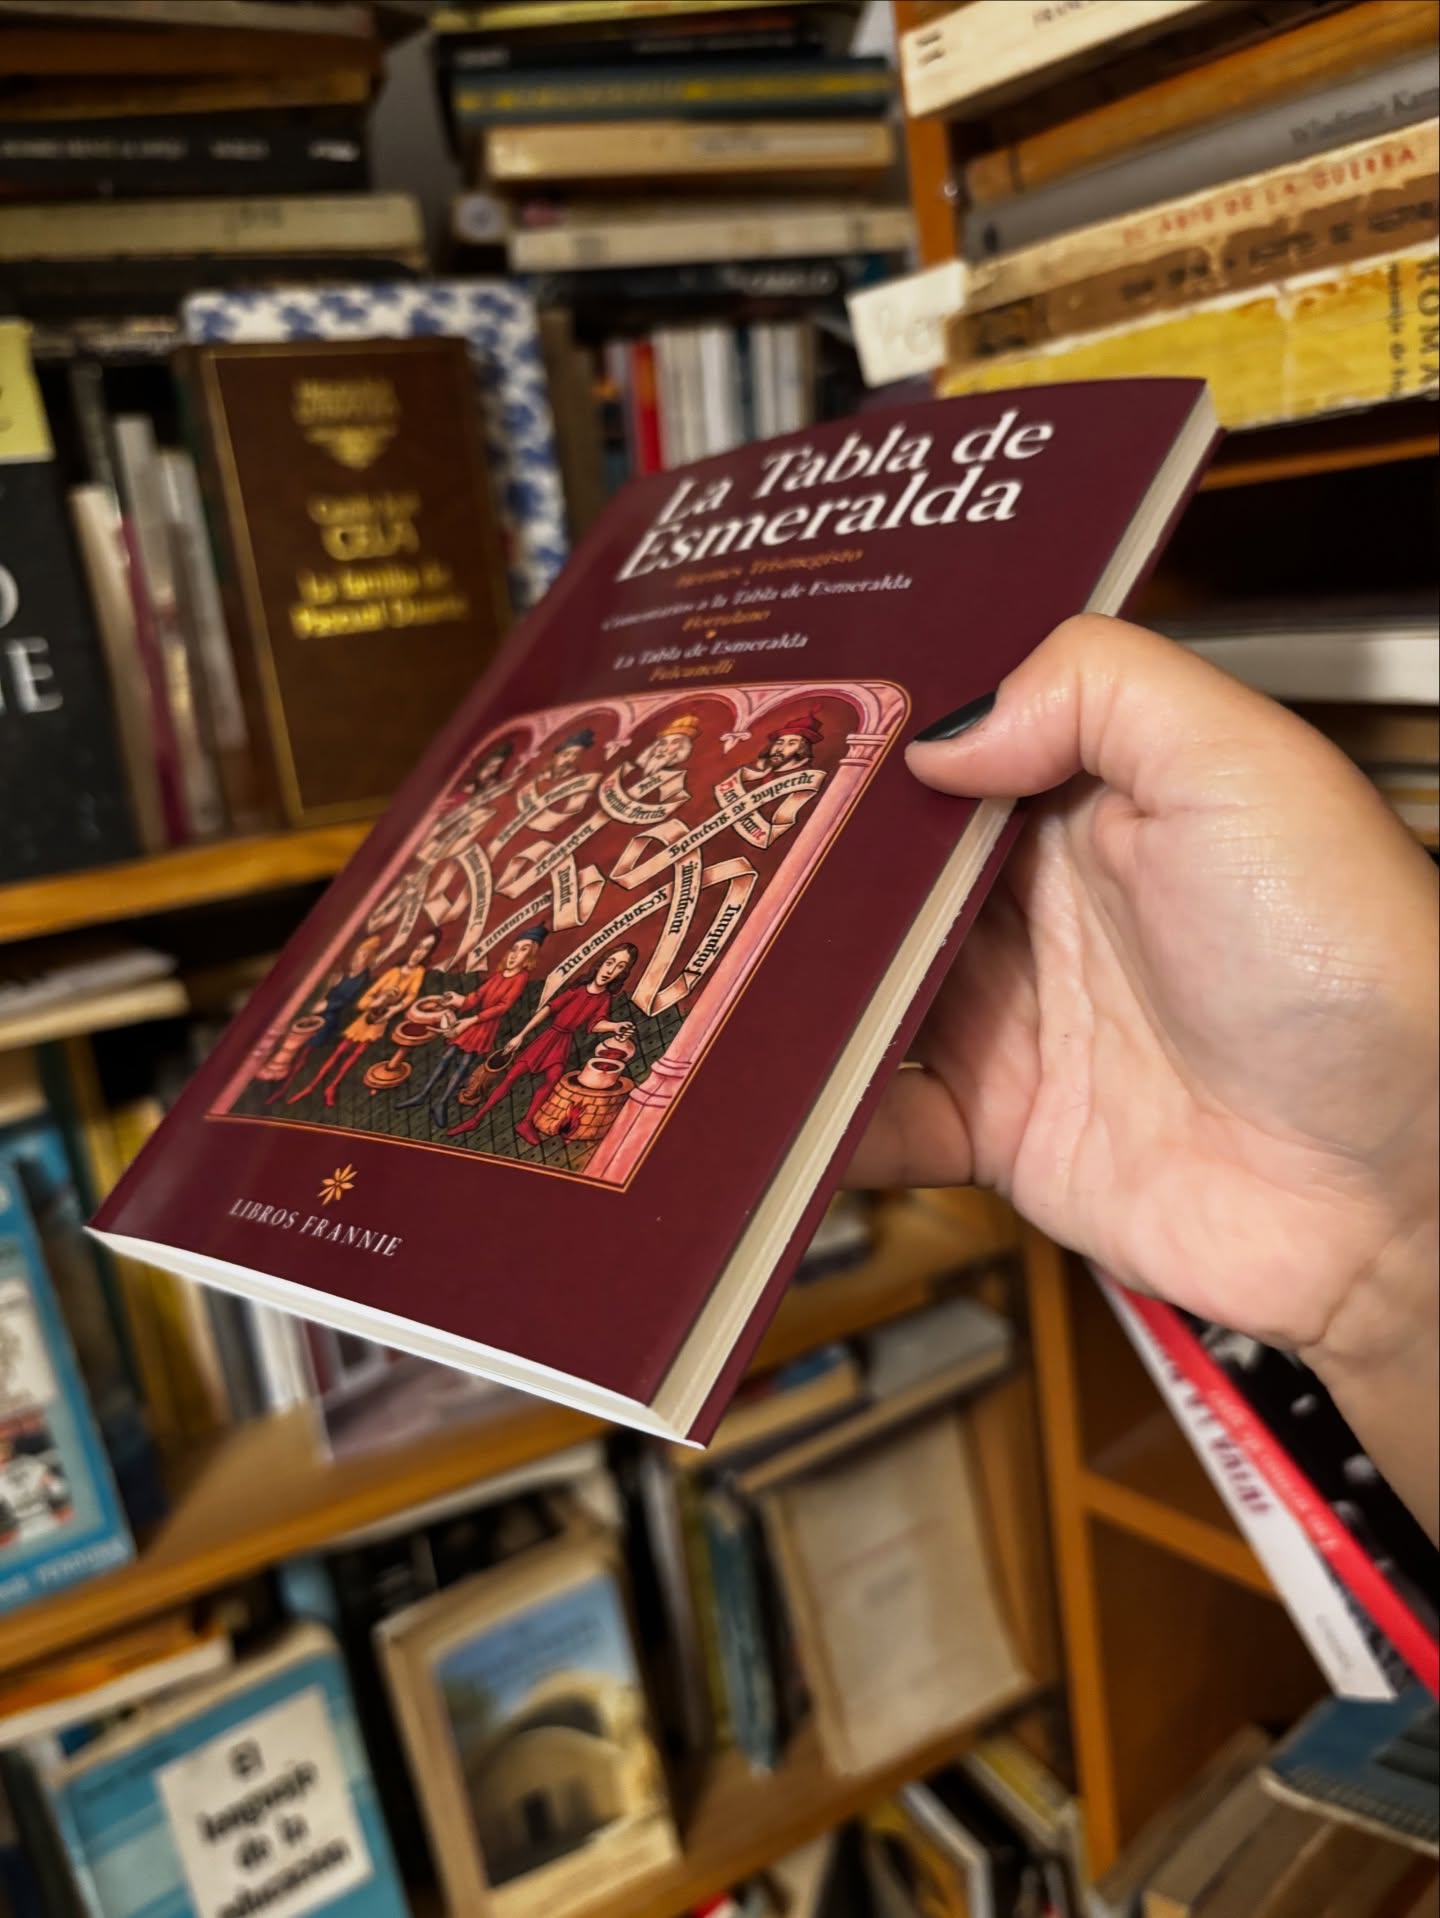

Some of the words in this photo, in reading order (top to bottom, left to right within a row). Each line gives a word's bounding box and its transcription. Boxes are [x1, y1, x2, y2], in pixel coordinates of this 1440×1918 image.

[656, 476, 734, 526] La
[752, 421, 934, 499] Tabla
[950, 407, 1055, 464] de
[615, 464, 1023, 582] Esmeralda
[731, 585, 779, 606] Tabla
[780, 581, 806, 600] de
[807, 571, 913, 597] Esmeralda
[613, 655, 635, 671] La
[637, 644, 683, 667] Tabla
[682, 642, 709, 658] de
[709, 631, 809, 656] Esmeralda
[229, 1199, 300, 1230] LIBROS
[299, 1214, 403, 1257] FRANNIE
